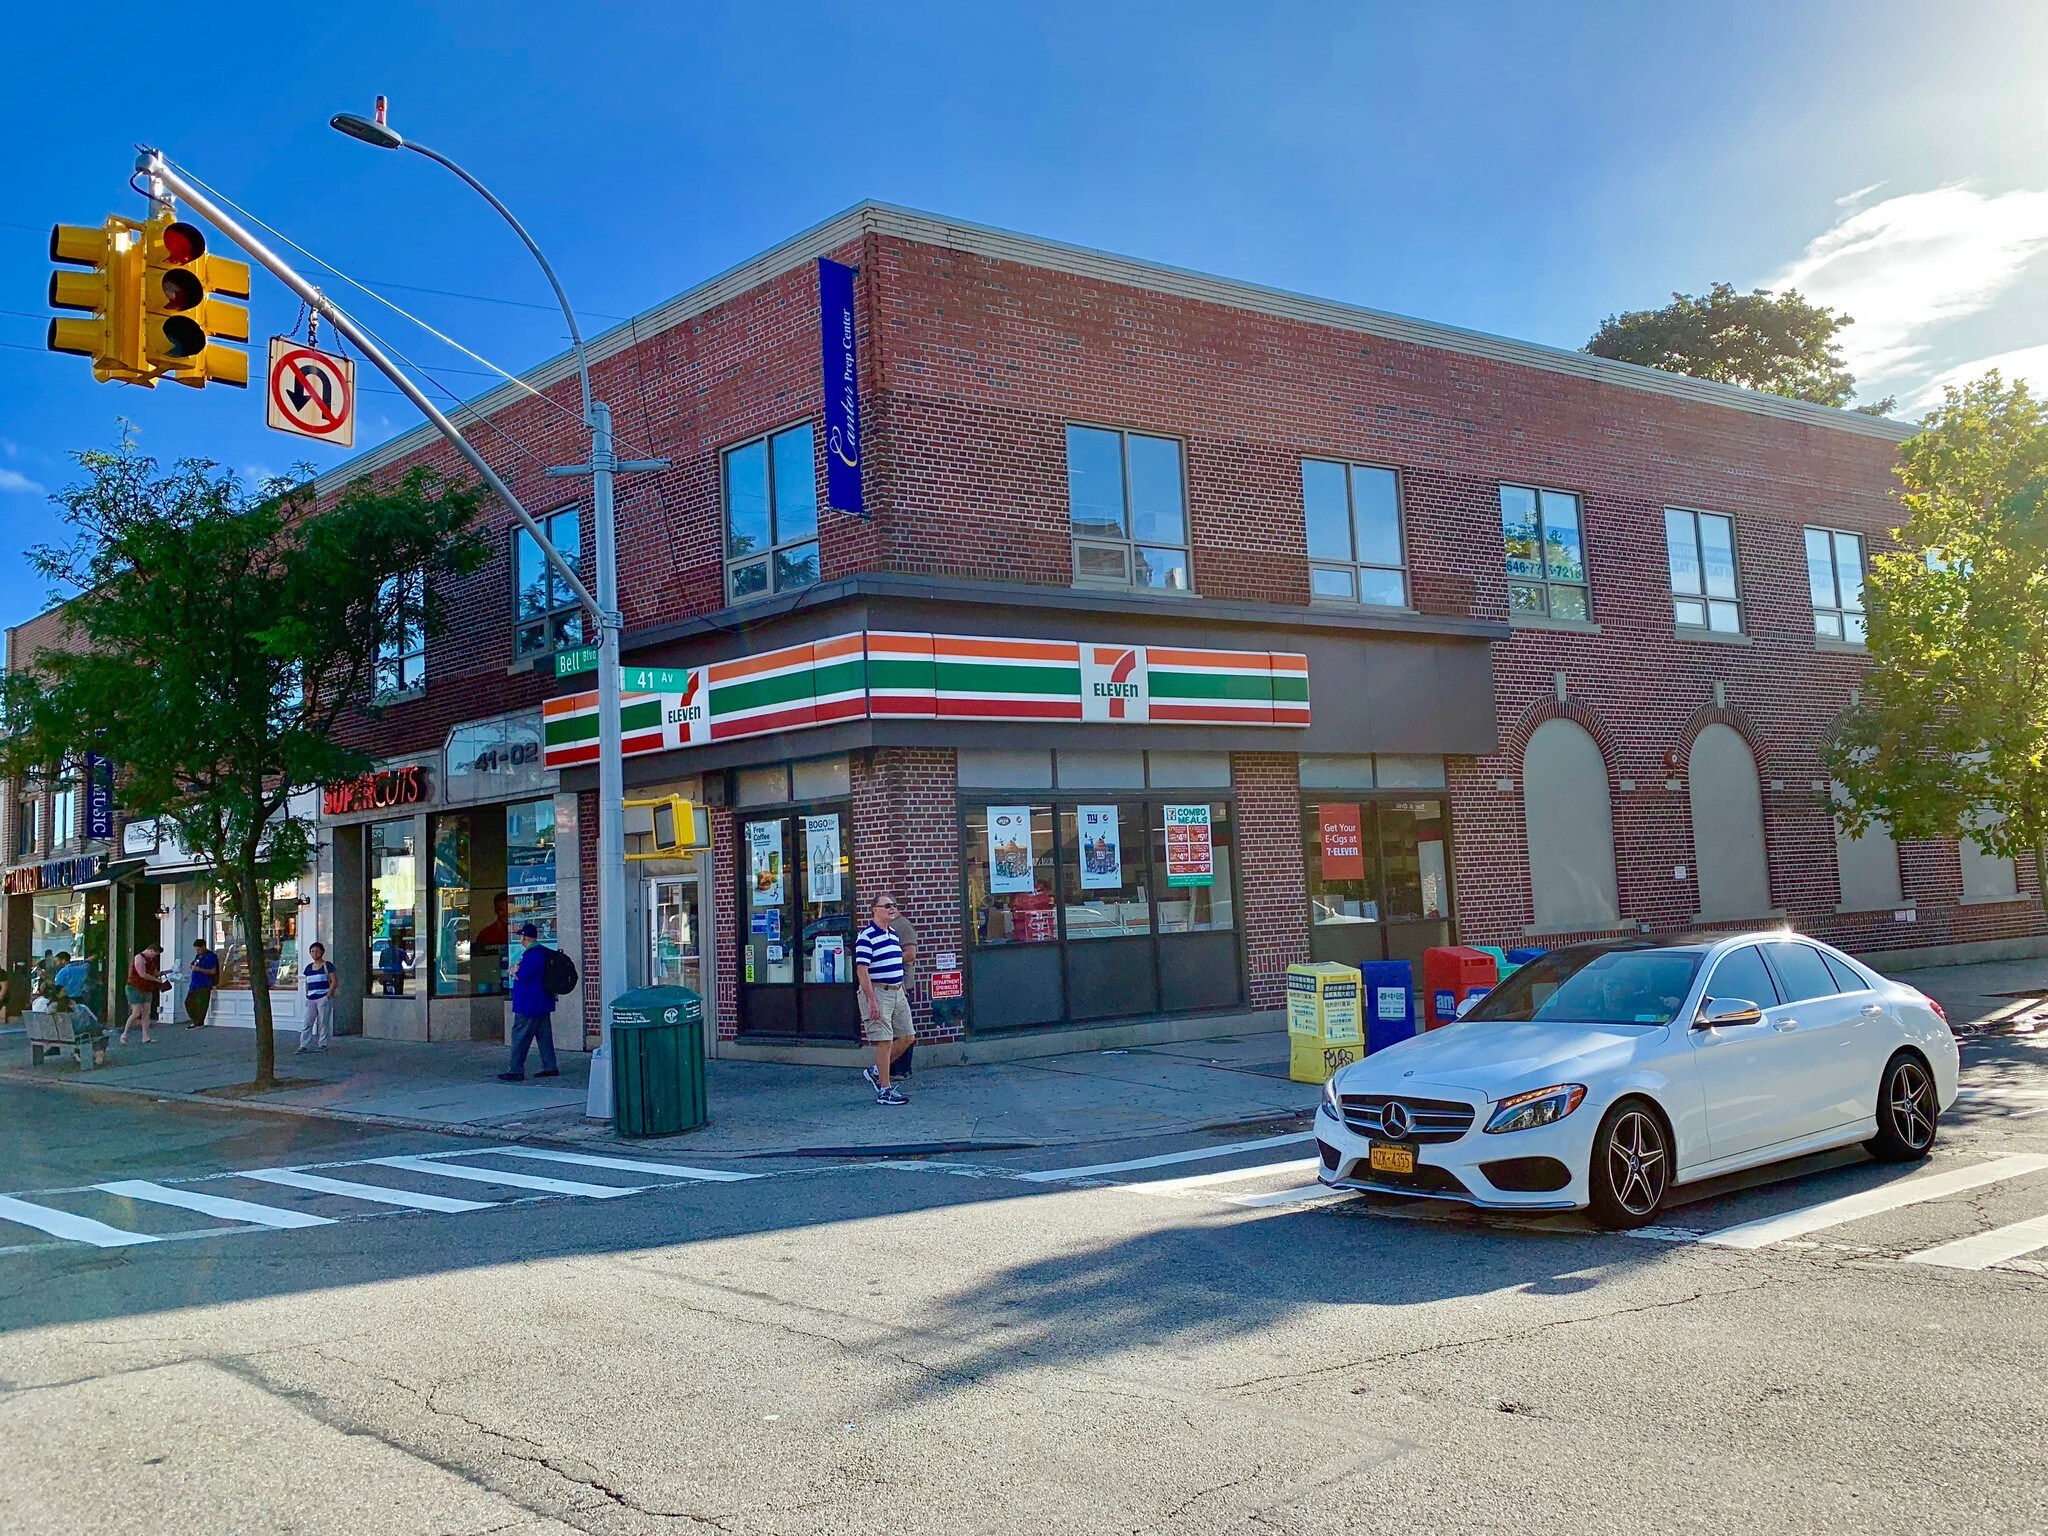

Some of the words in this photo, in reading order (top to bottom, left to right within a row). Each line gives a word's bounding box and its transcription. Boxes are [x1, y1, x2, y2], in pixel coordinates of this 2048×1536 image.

[842, 308, 852, 350] Center
[844, 353, 855, 382] Prep
[830, 386, 858, 467] Cantor
[560, 652, 580, 673] Bell
[582, 650, 597, 663] Blvd
[637, 671, 654, 689] 41
[1093, 648, 1136, 718] 7
[475, 742, 538, 772] 41-02
[93, 784, 107, 833] MUSIC
[1177, 808, 1207, 817] COMBO
[808, 819, 829, 829] BOGO
[1178, 816, 1208, 824] MEALS
[1324, 823, 1338, 833] Get
[1339, 823, 1356, 832] Your
[753, 826, 765, 834] Free
[753, 833, 770, 841] Coffee
[1325, 834, 1348, 846] E-Cigs
[1349, 835, 1357, 843] at
[933, 978, 960, 986] DEPARTMENT
[1436, 994, 1455, 1010] am
